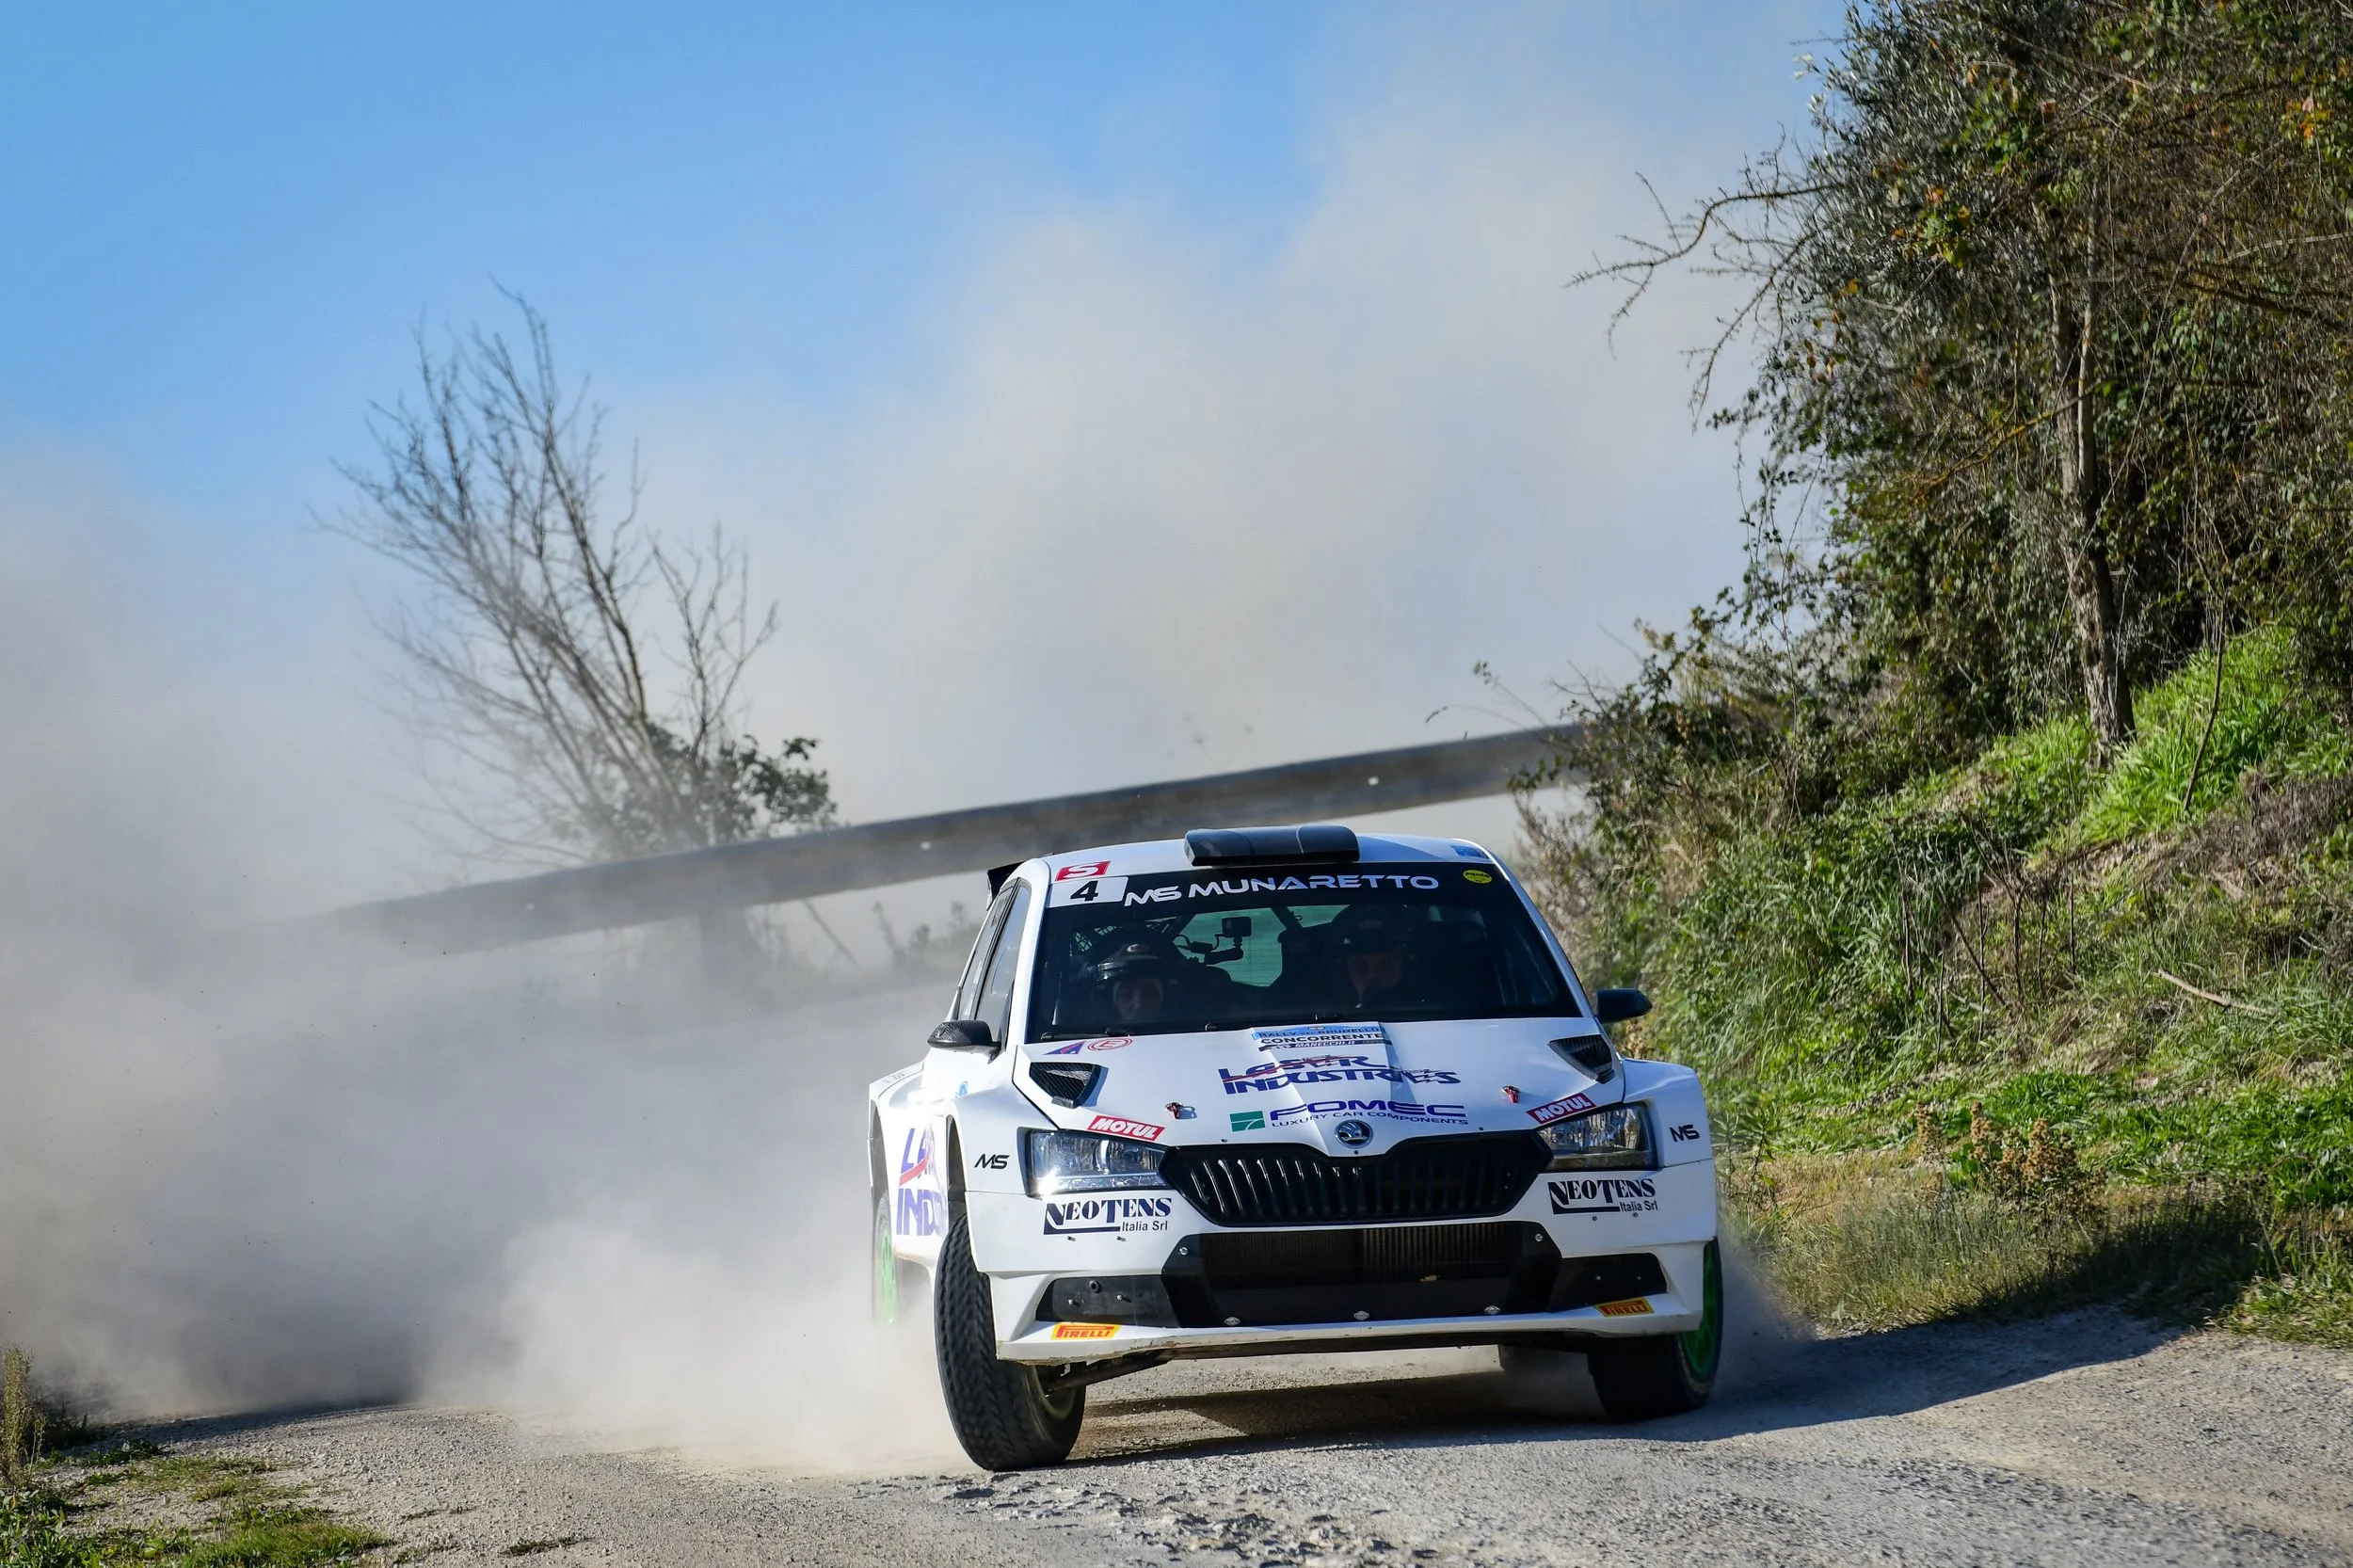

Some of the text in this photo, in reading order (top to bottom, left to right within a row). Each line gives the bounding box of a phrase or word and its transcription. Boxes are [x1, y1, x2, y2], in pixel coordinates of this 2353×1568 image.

[1070, 880, 1099, 902] 4
[1124, 886, 1182, 907] MS
[1188, 874, 1439, 899] MUNARETTO
[1261, 1033, 1383, 1045] CONCORRENTE
[1270, 1099, 1466, 1121] FOMEC
[1534, 1096, 1592, 1122] MOTUL
[1090, 1117, 1159, 1139] MOTUL
[1272, 1112, 1328, 1128] LUXURY
[1368, 1112, 1469, 1126] COMPONENTS
[1670, 1124, 1700, 1143] MS
[973, 1153, 1010, 1170] MS
[1547, 1177, 1656, 1206] NEOTENS
[1045, 1197, 1173, 1226] NEOTENS
[1619, 1200, 1658, 1212] Italia Srl
[1122, 1220, 1168, 1232] Italia Srl
[1055, 1324, 1115, 1338] PIRELLI
